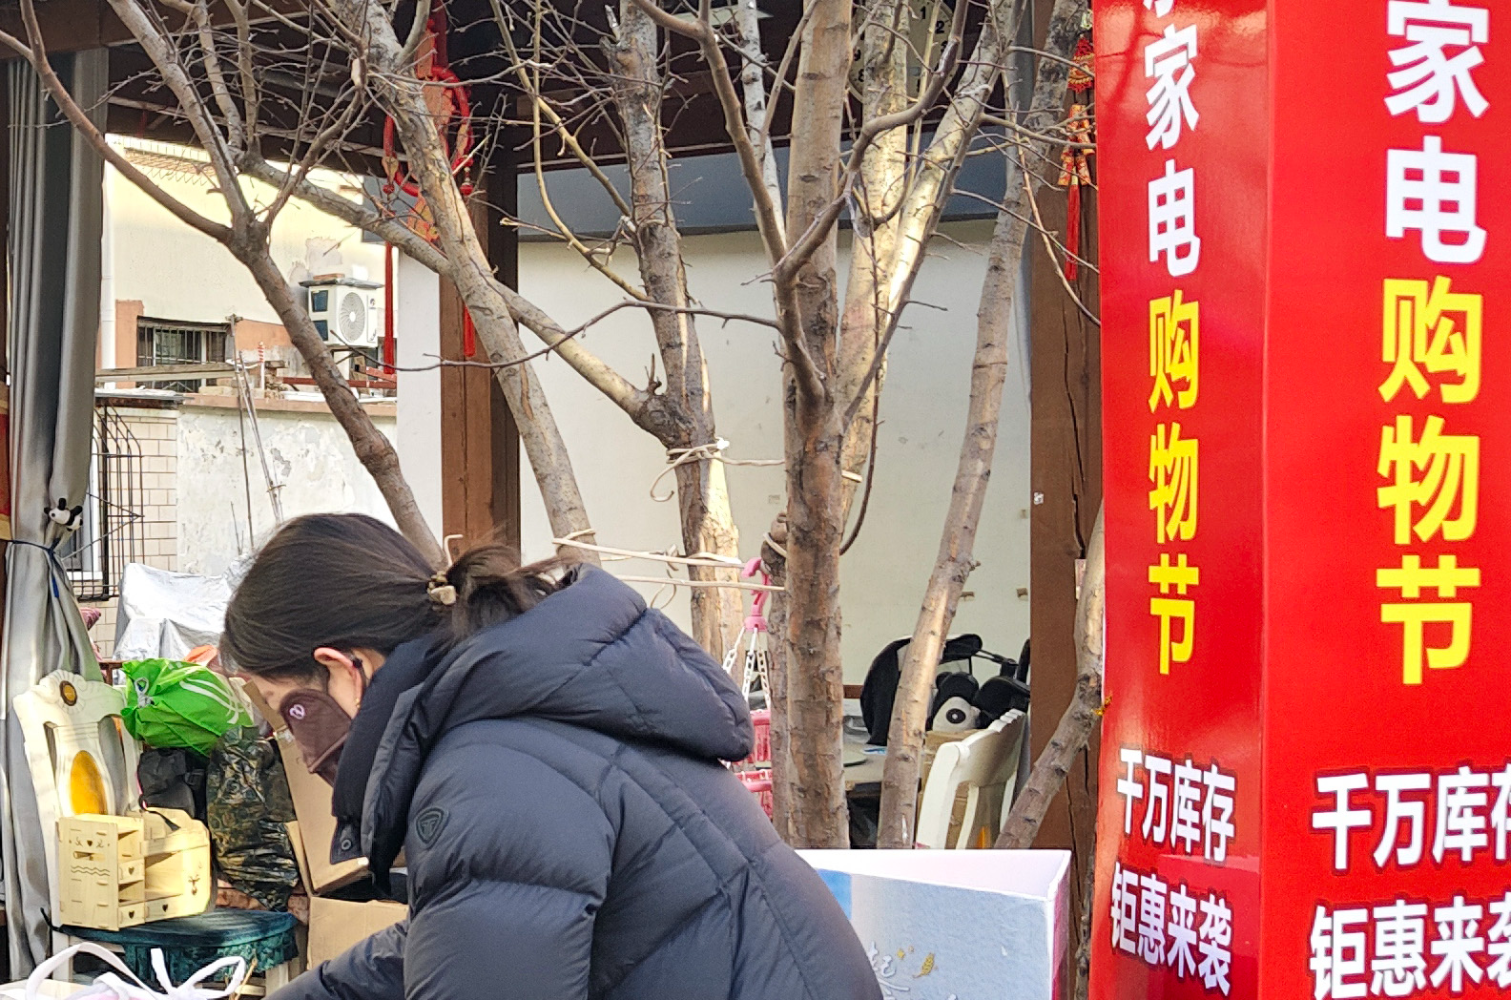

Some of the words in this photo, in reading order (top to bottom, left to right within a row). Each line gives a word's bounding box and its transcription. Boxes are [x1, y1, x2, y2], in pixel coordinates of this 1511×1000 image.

[1143, 0, 1200, 675] 家电购物节
[1377, 0, 1490, 684] 家电购物节
[1109, 862, 1234, 997] 钜惠来袭
[1117, 748, 1236, 863] 千万库存
